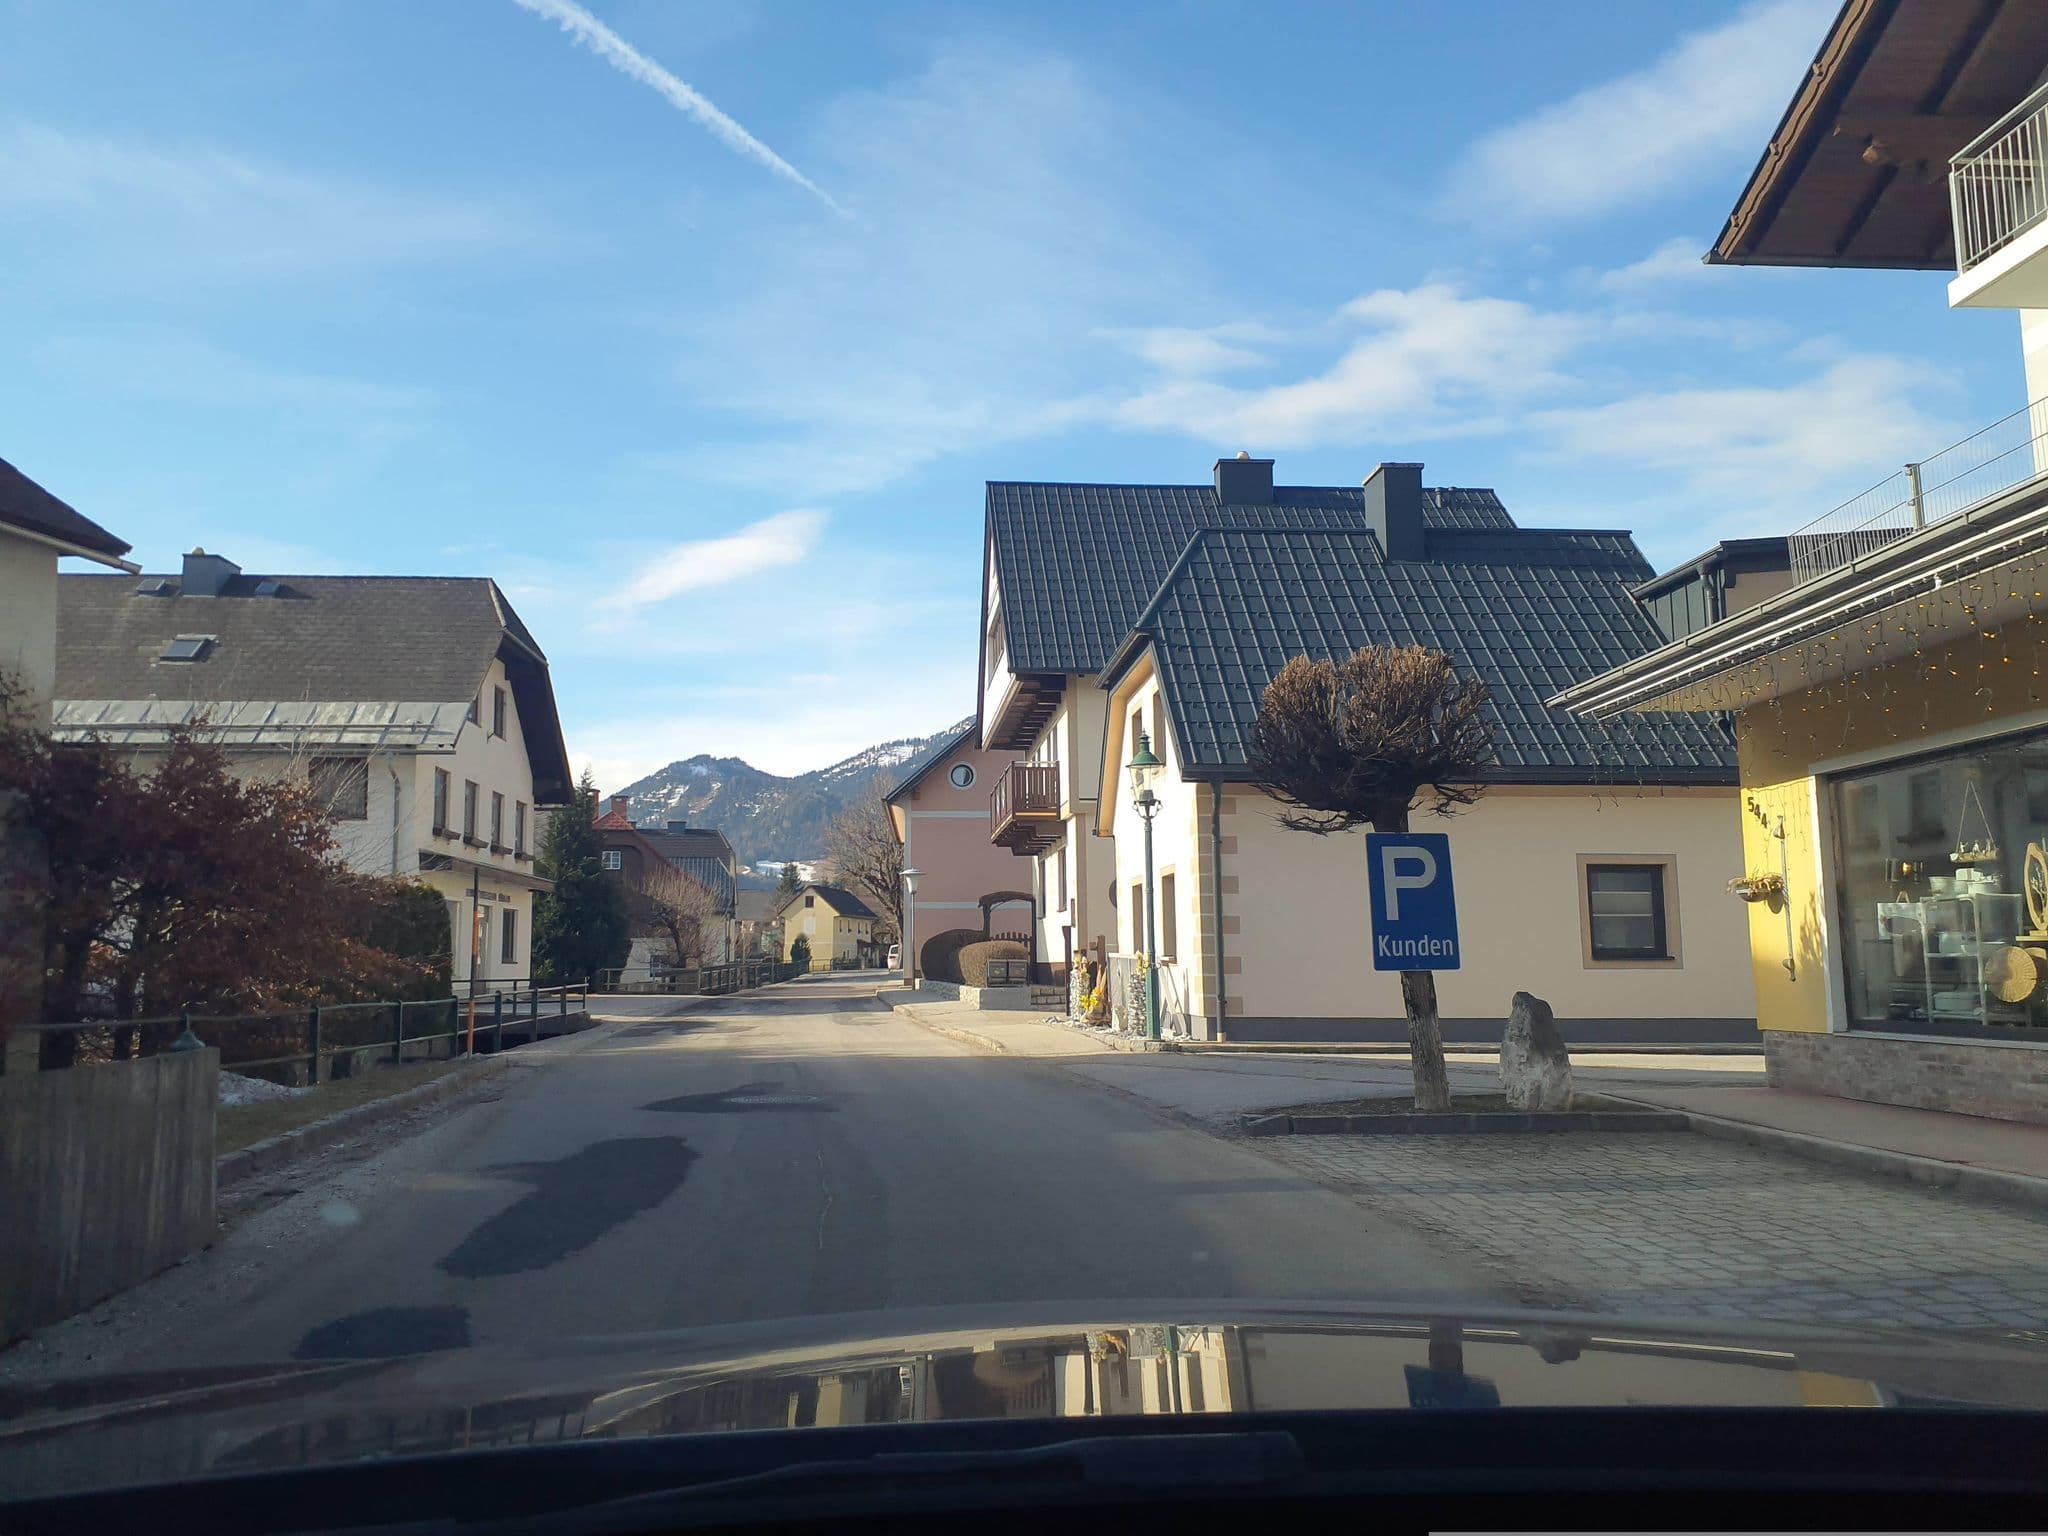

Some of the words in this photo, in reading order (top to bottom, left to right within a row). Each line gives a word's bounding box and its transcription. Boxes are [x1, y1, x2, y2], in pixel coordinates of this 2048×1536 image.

[1747, 796, 1768, 829] 544
[1381, 846, 1437, 921] P
[1378, 934, 1454, 957] Kunden
